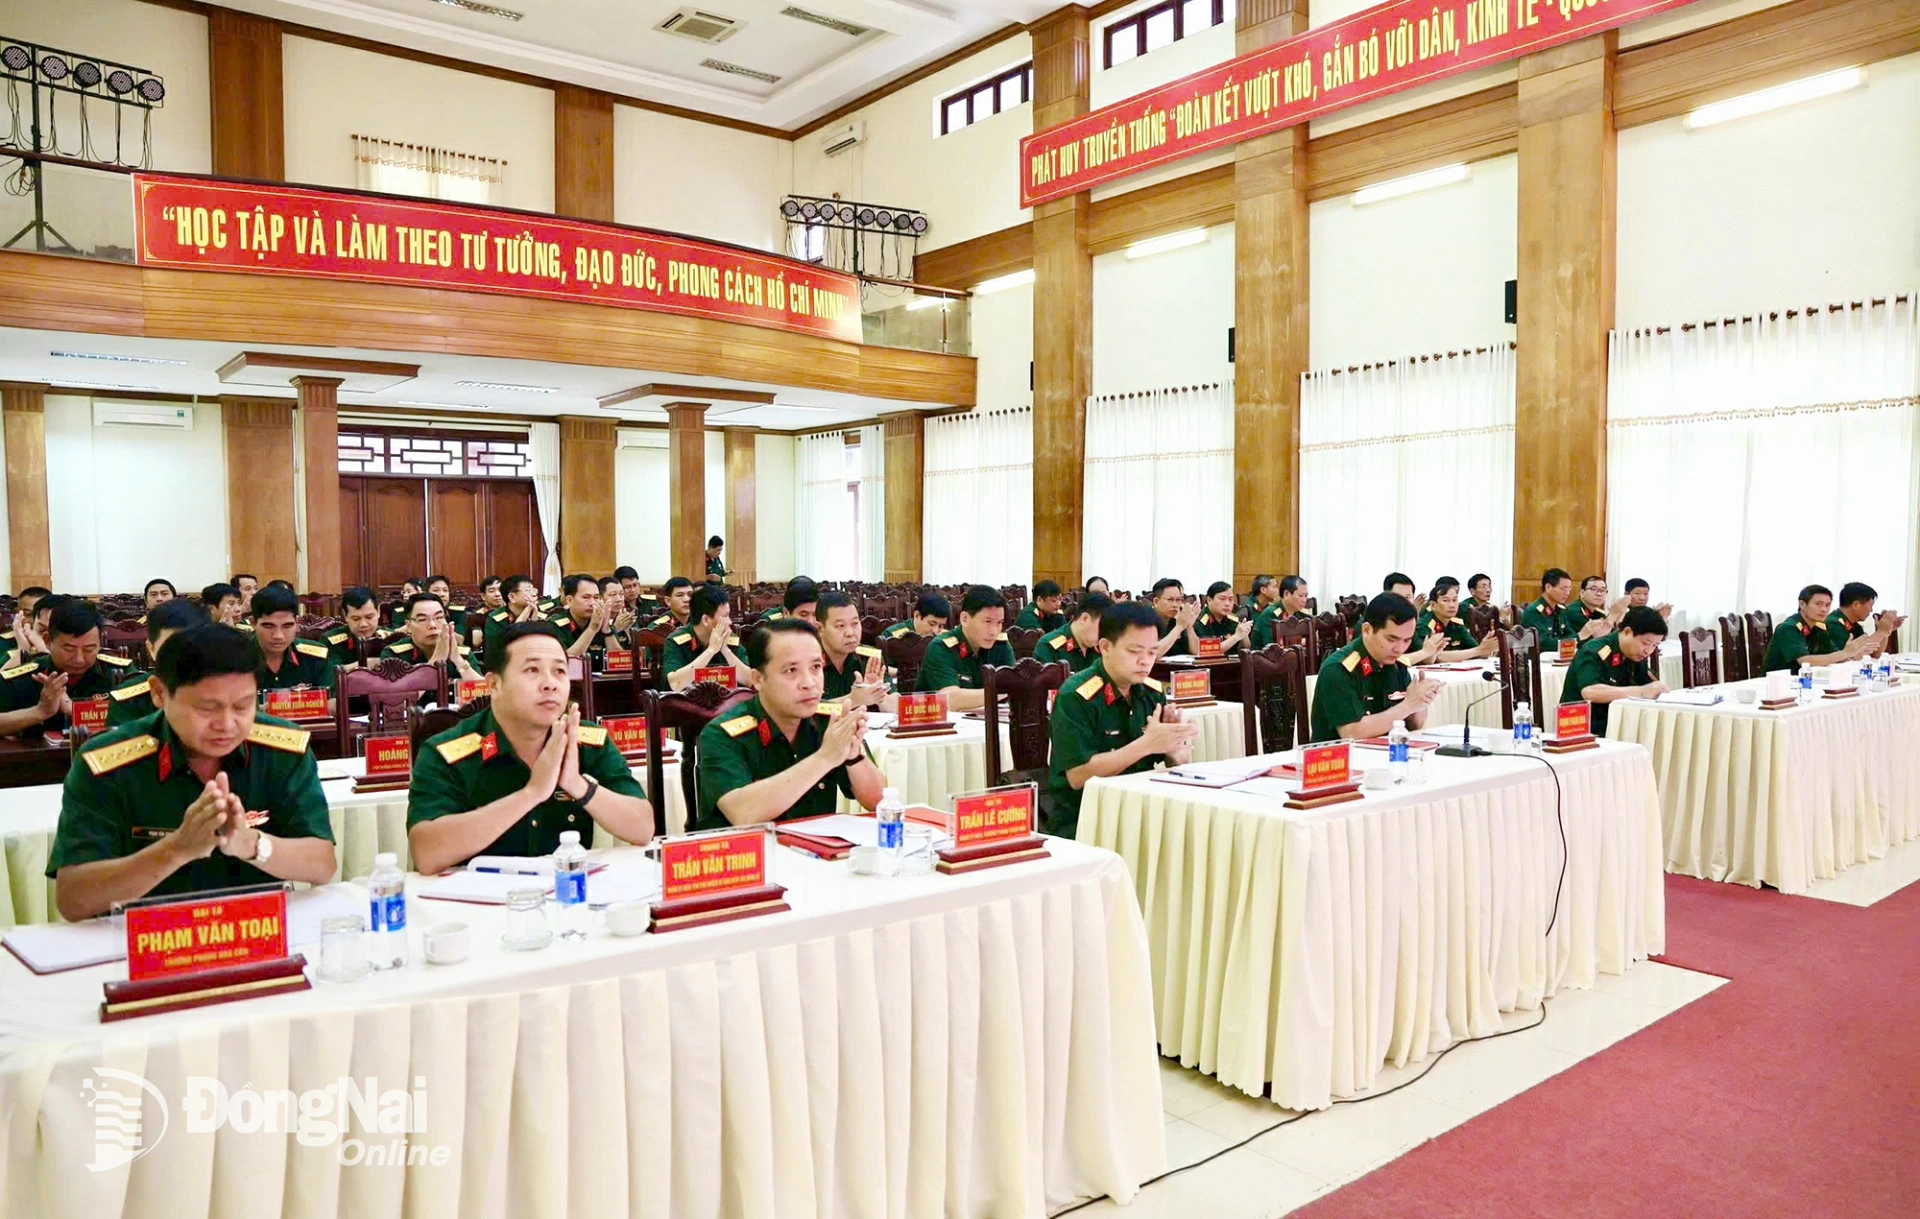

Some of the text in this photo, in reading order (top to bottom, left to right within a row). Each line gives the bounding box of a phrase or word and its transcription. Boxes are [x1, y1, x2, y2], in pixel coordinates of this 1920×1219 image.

[1031, 147, 1057, 188] PHÁT
[1060, 143, 1080, 179] HUY
[1083, 117, 1126, 169] TRUYỀN
[1129, 105, 1166, 155] THỐNG
[1214, 75, 1240, 126] KẾT
[1244, 69, 1279, 119] VƯỢT
[1284, 52, 1317, 102] KHÓ,
[1323, 35, 1354, 92] GẮN
[1359, 30, 1379, 77] BÓ
[1385, 21, 1414, 71] VỚI
[1419, 8, 1460, 57] DÂN,
[1467, 0, 1508, 46] KINH
[236, 204, 285, 260] TẬP
[294, 209, 327, 256] VÀ
[336, 213, 388, 261] LÀM
[396, 226, 452, 268] THEO
[460, 230, 487, 272] TƯ
[494, 230, 567, 285] TƯỞNG,
[575, 246, 615, 291] ĐẠO
[621, 248, 662, 296] ĐỨC,
[668, 259, 720, 300] PHONG
[724, 263, 763, 307] CÁCH
[767, 271, 785, 311] HỒ
[790, 278, 811, 316] CHÍ
[137, 916, 280, 955] PHẠM VĂN TOẠI
